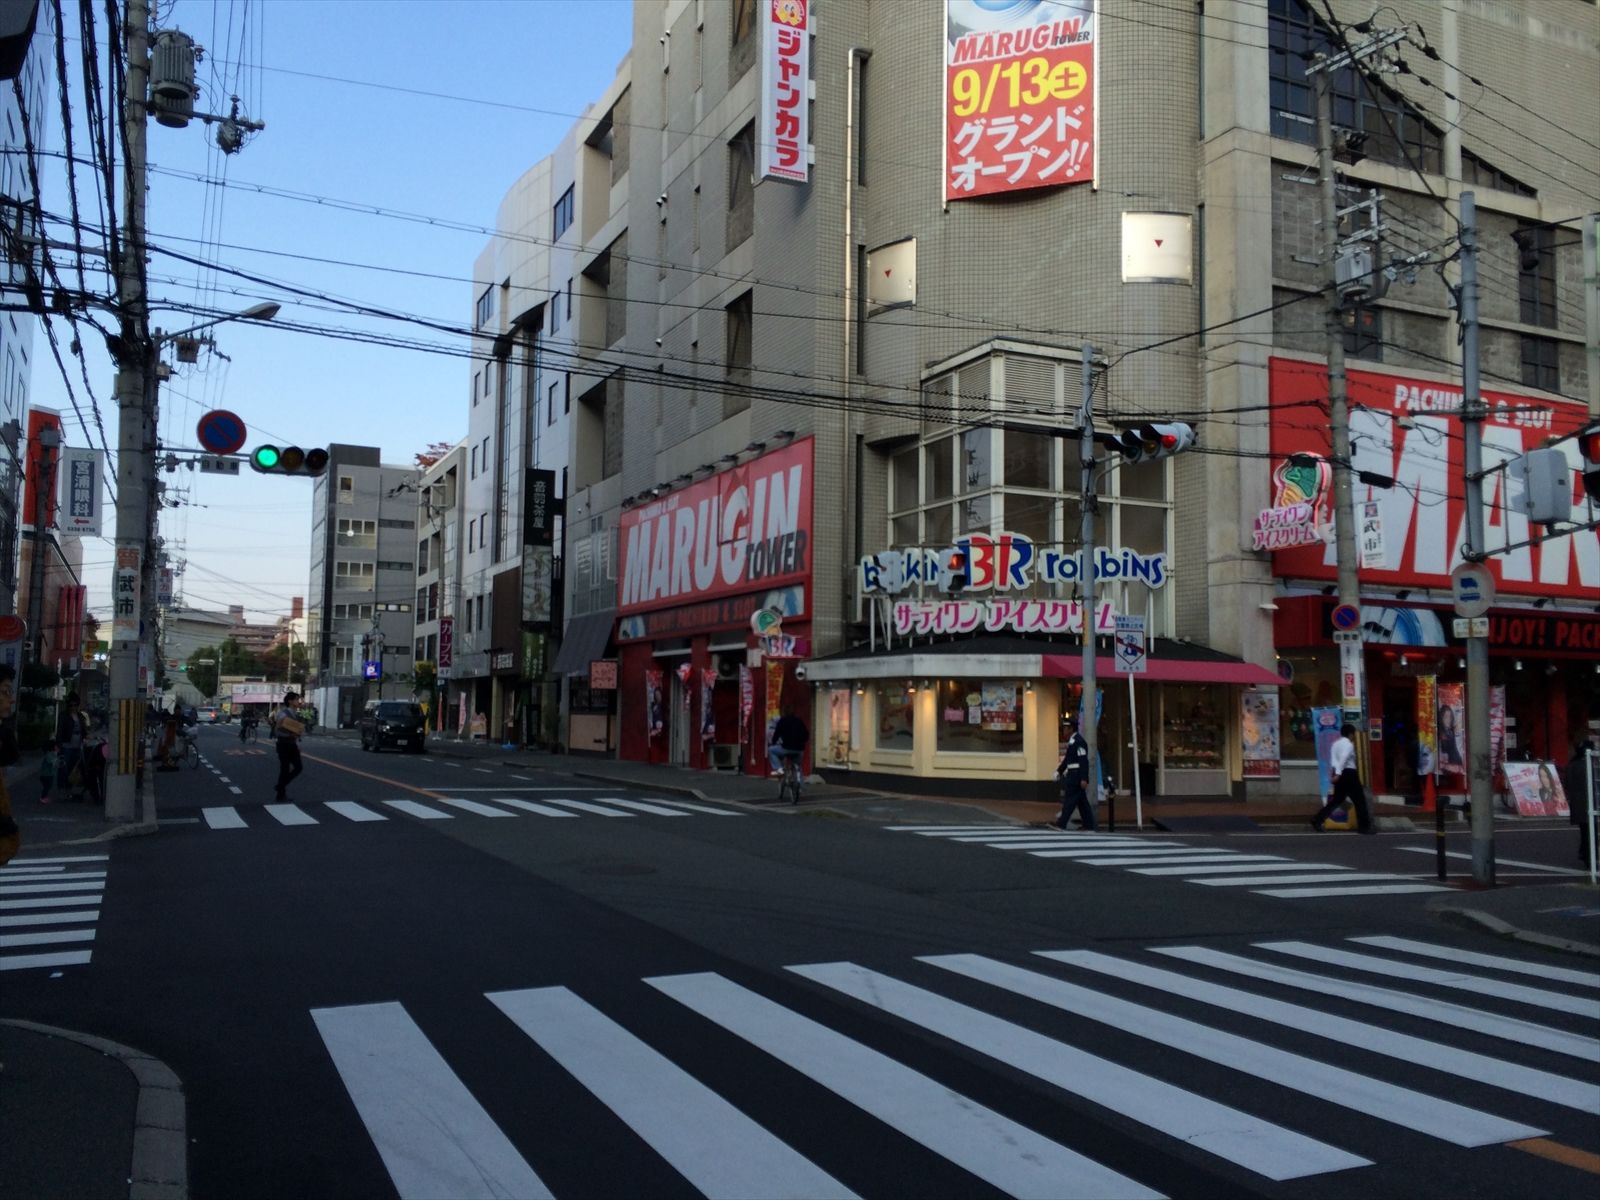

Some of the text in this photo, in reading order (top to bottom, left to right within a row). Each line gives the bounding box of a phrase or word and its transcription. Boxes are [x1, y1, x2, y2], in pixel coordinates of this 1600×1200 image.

[953, 18, 1091, 63] MARUGIN TOWER
[775, 29, 801, 168] ジャンカラ
[954, 105, 1086, 157] グランド
[622, 464, 802, 607] MARUGIN
[1255, 525, 1315, 548] アイスクリーム
[1262, 506, 1309, 528] サーティワン
[746, 529, 807, 582] TOWER
[119, 575, 135, 617] 武市
[897, 601, 1115, 631] サーティワン アイスクリム
